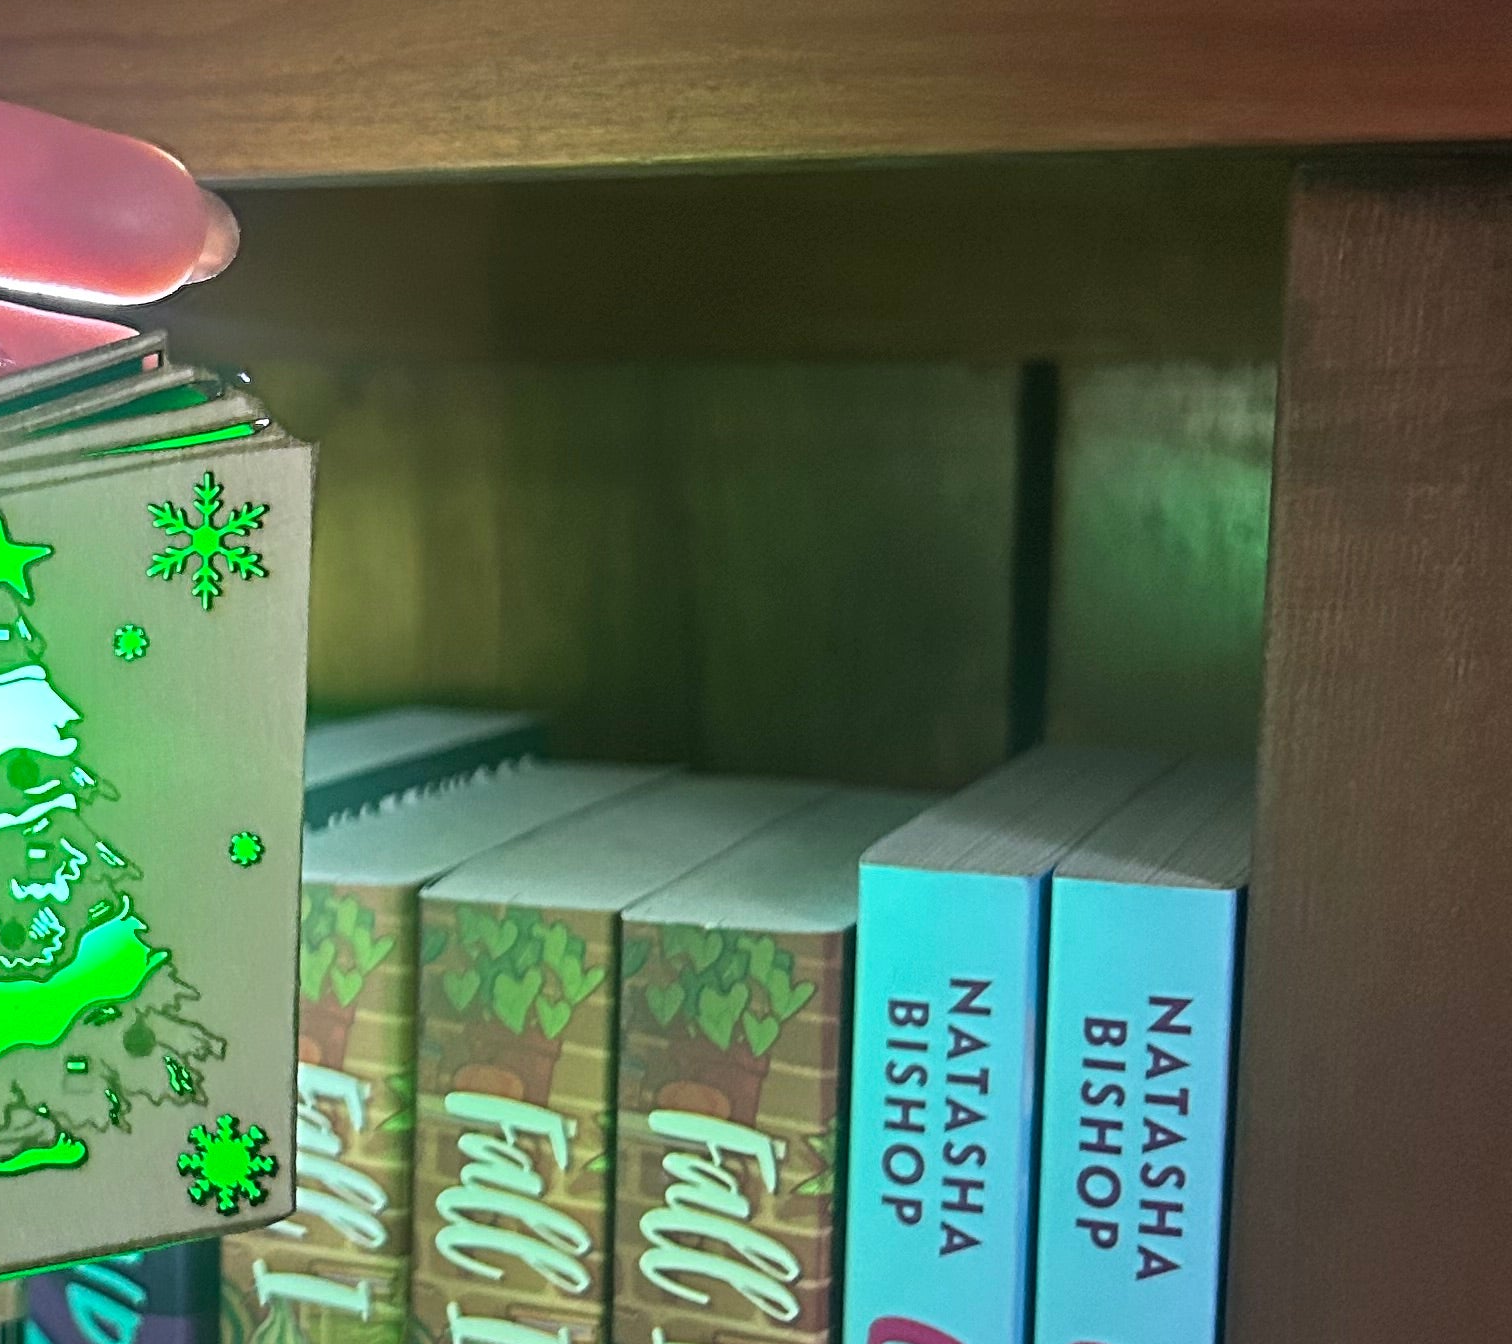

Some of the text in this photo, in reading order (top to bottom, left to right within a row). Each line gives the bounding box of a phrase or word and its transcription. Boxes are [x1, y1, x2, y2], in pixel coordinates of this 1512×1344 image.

[435, 1090, 592, 1295] Fall
[639, 1109, 800, 1323] Fall
[882, 1000, 930, 1226] BISHOP
[939, 978, 992, 1256] NATASHA
[1077, 1017, 1127, 1250] BISHOP
[1135, 995, 1192, 1281] NATASHA
[253, 1259, 371, 1319] I
